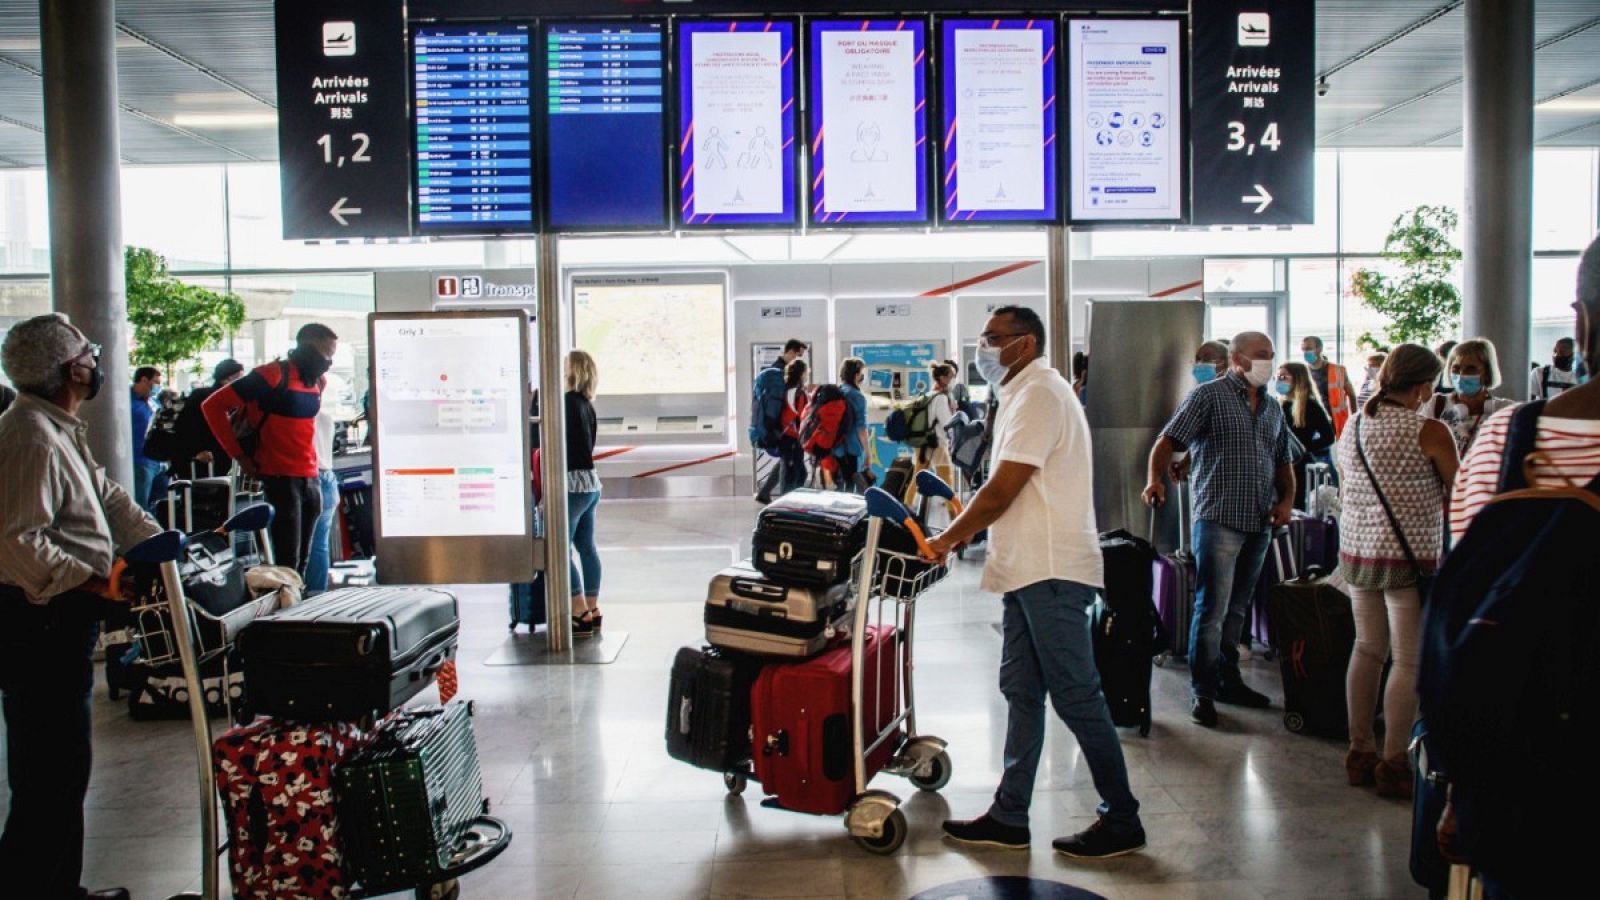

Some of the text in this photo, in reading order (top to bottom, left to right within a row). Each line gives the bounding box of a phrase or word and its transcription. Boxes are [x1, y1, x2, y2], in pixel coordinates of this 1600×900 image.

[1226, 65, 1281, 78] Arrivées
[312, 75, 369, 89] Arrivées
[1227, 80, 1280, 93] Arrivals
[314, 91, 368, 104] Arrivals
[330, 107, 353, 119] 到达
[1227, 121, 1281, 156] 3,4
[317, 132, 372, 168] 1,2
